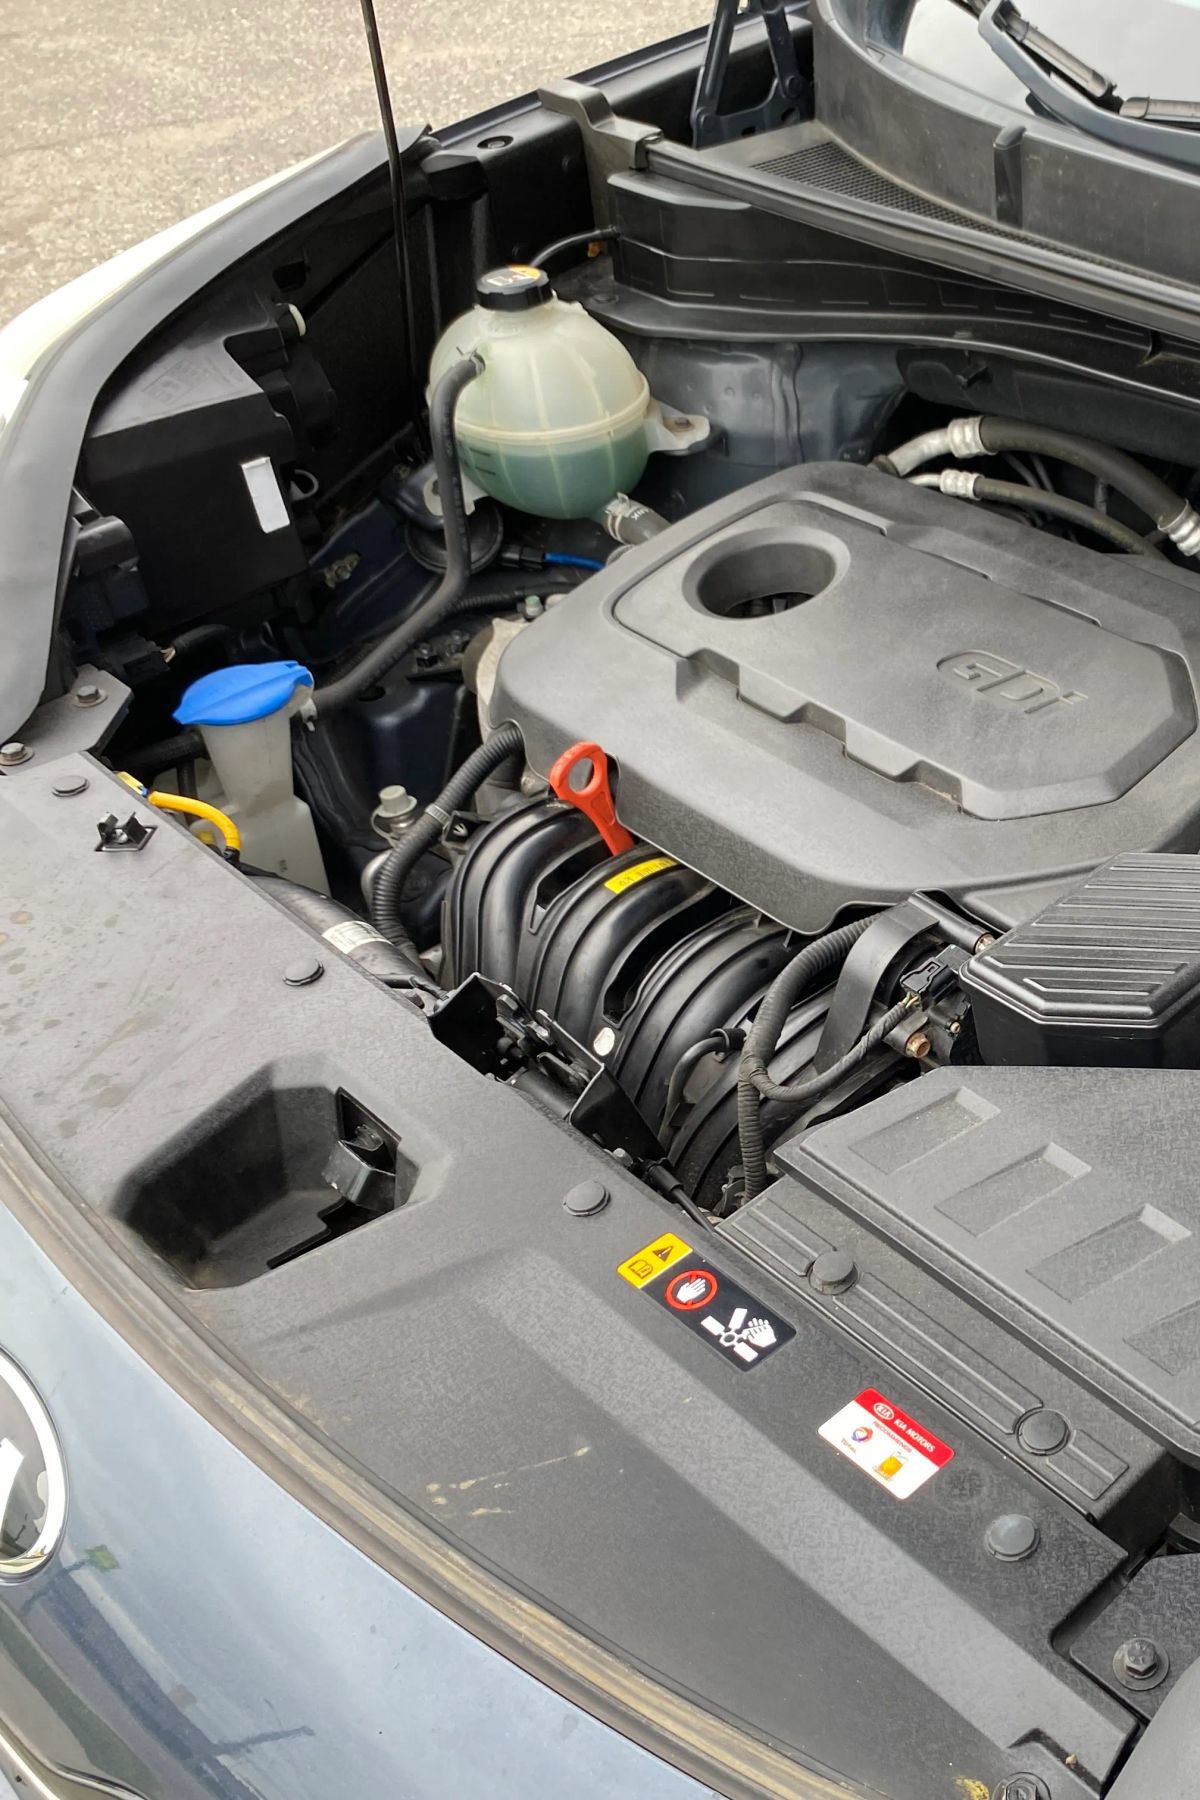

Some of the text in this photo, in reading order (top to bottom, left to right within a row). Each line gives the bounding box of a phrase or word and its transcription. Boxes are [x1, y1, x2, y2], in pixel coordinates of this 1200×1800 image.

[876, 1402, 936, 1453] KIA KIA MOTORS
